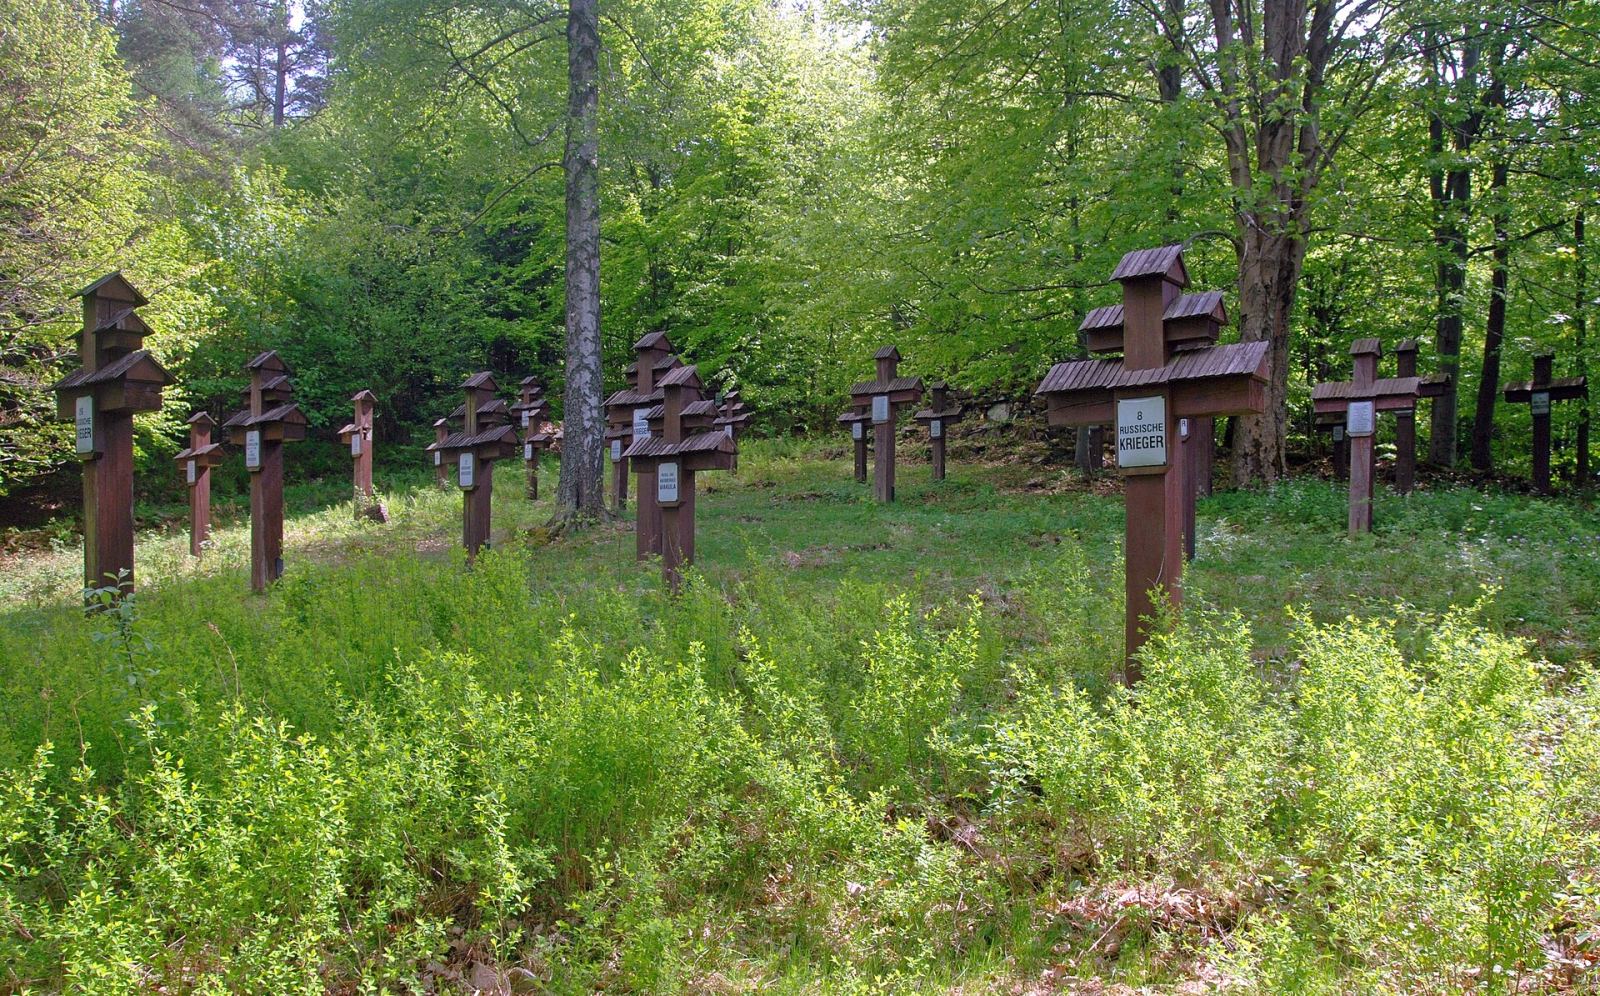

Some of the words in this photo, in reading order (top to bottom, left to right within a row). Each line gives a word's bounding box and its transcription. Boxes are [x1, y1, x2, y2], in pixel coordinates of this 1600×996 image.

[1137, 410, 1143, 421] 8
[1119, 422, 1164, 435] RUSSISCHE
[1119, 435, 1164, 451] KRIEGER
